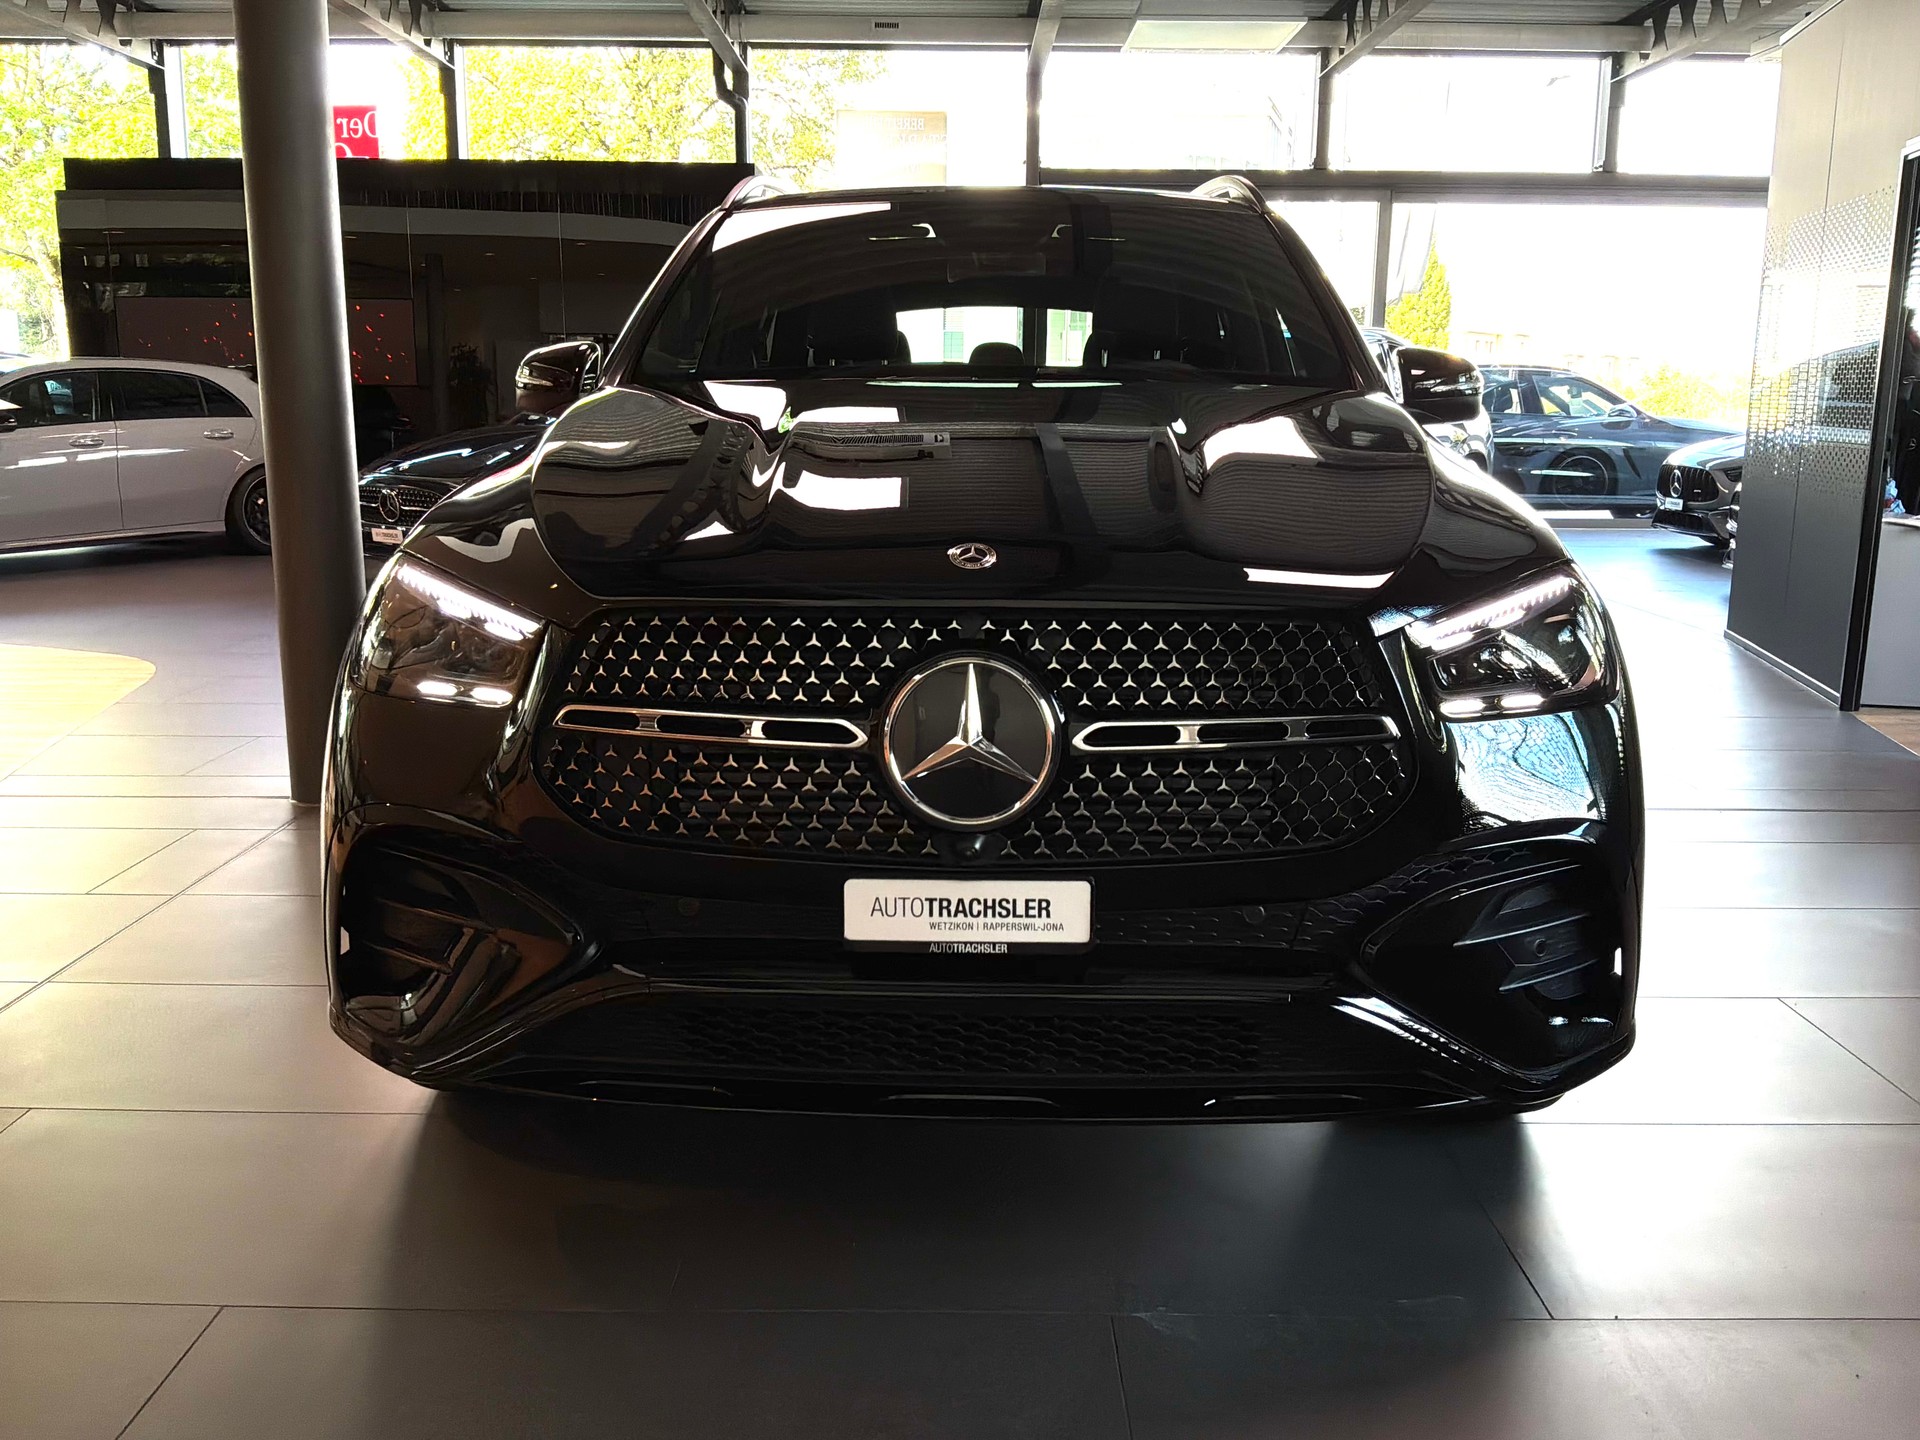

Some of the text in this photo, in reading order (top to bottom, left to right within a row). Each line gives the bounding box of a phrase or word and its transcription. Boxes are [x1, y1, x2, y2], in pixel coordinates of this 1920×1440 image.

[870, 896, 1052, 919] AUTOTRACHSLER
[929, 921, 974, 932] WETZIKON
[982, 922, 1065, 933] RAPPERSWIL-JONA
[929, 943, 1008, 954] AUTOTRACHSLER
